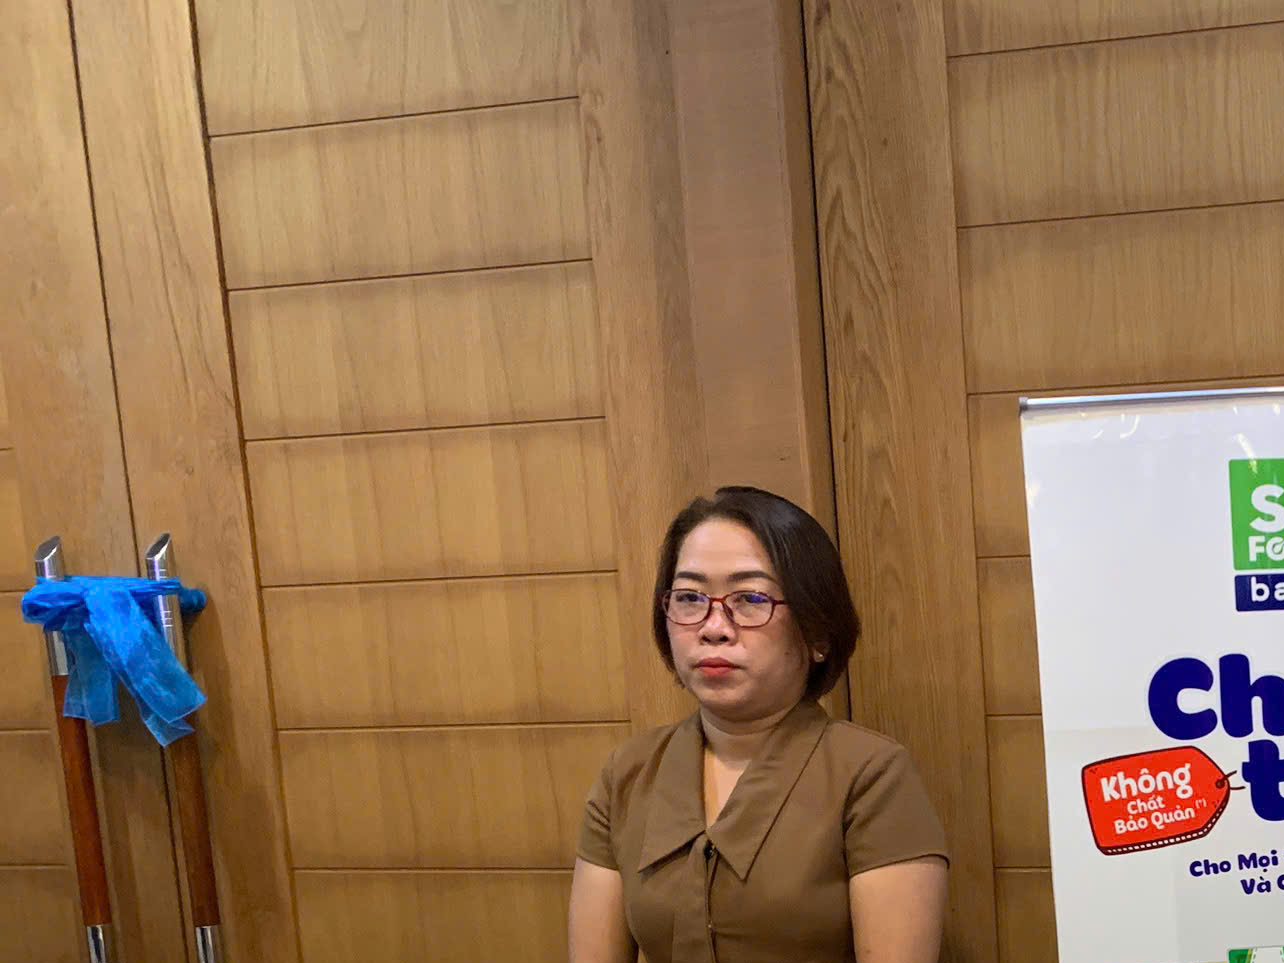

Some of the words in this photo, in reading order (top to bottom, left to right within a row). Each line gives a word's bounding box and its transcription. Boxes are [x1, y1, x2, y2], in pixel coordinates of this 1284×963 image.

[1100, 763, 1194, 802] Không
[1127, 795, 1165, 814] Chất
[1114, 815, 1148, 834] Bảo
[1189, 859, 1231, 877] Cho
[1238, 849, 1278, 873] Mọi
[1240, 876, 1271, 895] Và
